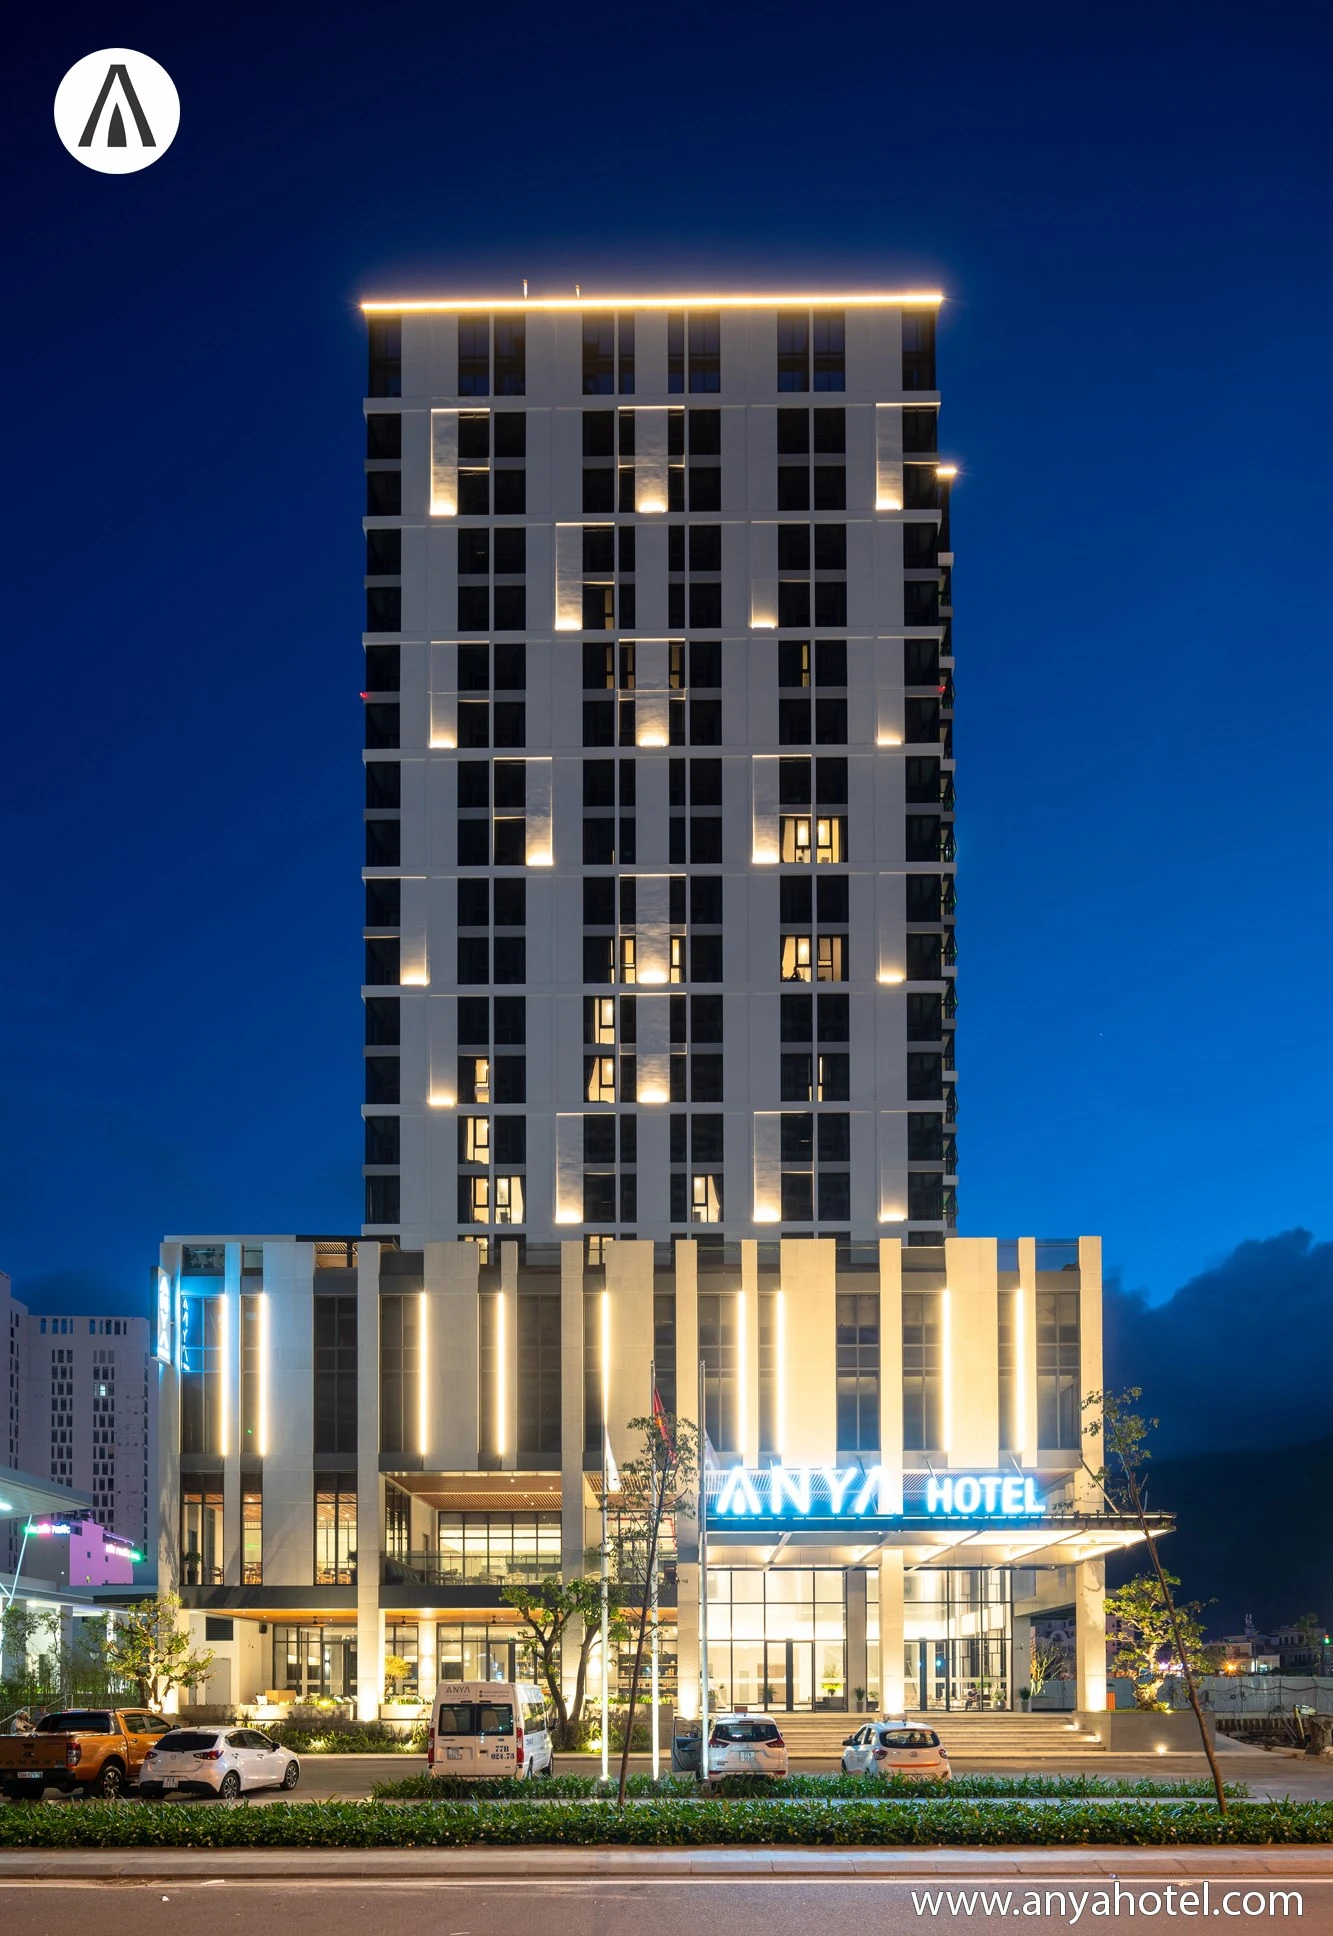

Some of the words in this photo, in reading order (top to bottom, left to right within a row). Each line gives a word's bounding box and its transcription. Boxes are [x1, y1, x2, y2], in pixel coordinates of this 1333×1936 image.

[715, 1465, 898, 1515] ANYA
[926, 1476, 1047, 1514] HOTEL
[445, 1686, 470, 1694] ANYA
